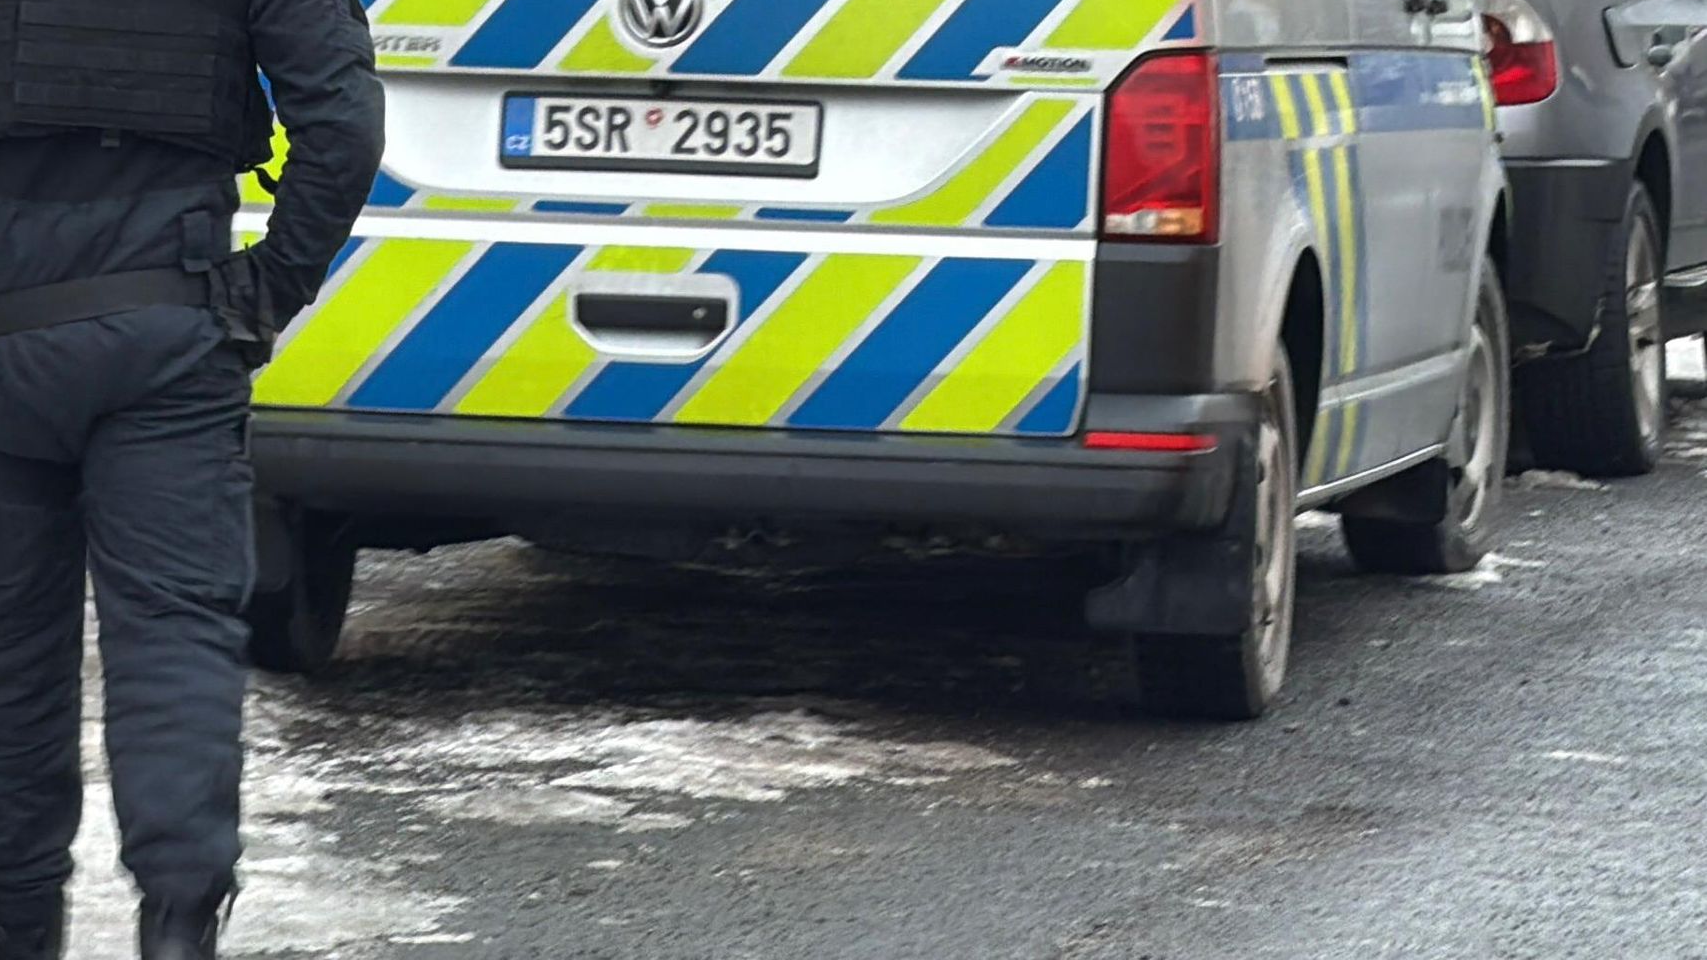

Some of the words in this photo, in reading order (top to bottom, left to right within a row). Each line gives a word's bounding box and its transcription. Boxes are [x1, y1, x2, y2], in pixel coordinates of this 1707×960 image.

[505, 134, 530, 151] CZ
[544, 105, 631, 152] 5SR
[672, 110, 793, 158] 2935
